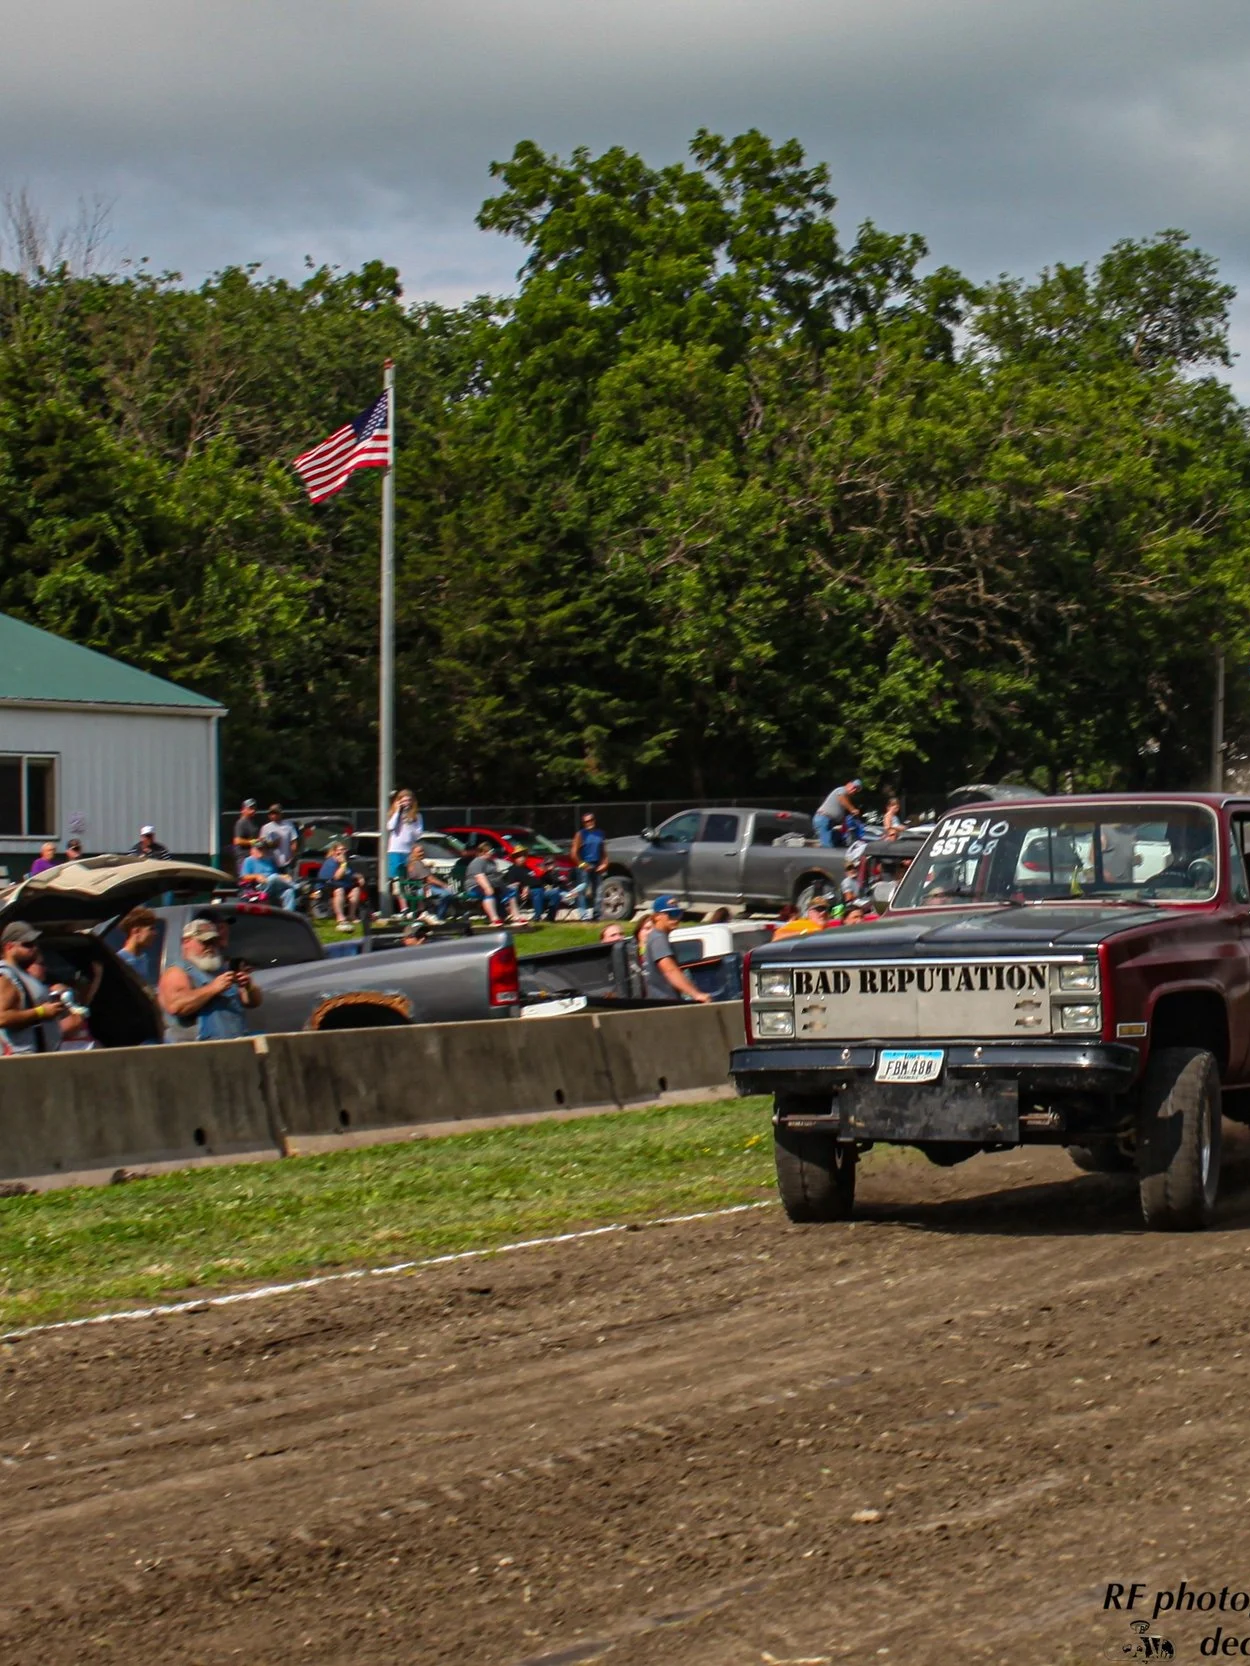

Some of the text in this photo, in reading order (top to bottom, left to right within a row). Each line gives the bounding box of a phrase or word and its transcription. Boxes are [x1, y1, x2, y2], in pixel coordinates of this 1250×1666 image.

[929, 836, 970, 857] SST
[794, 965, 1047, 995] BAD REPUTATION
